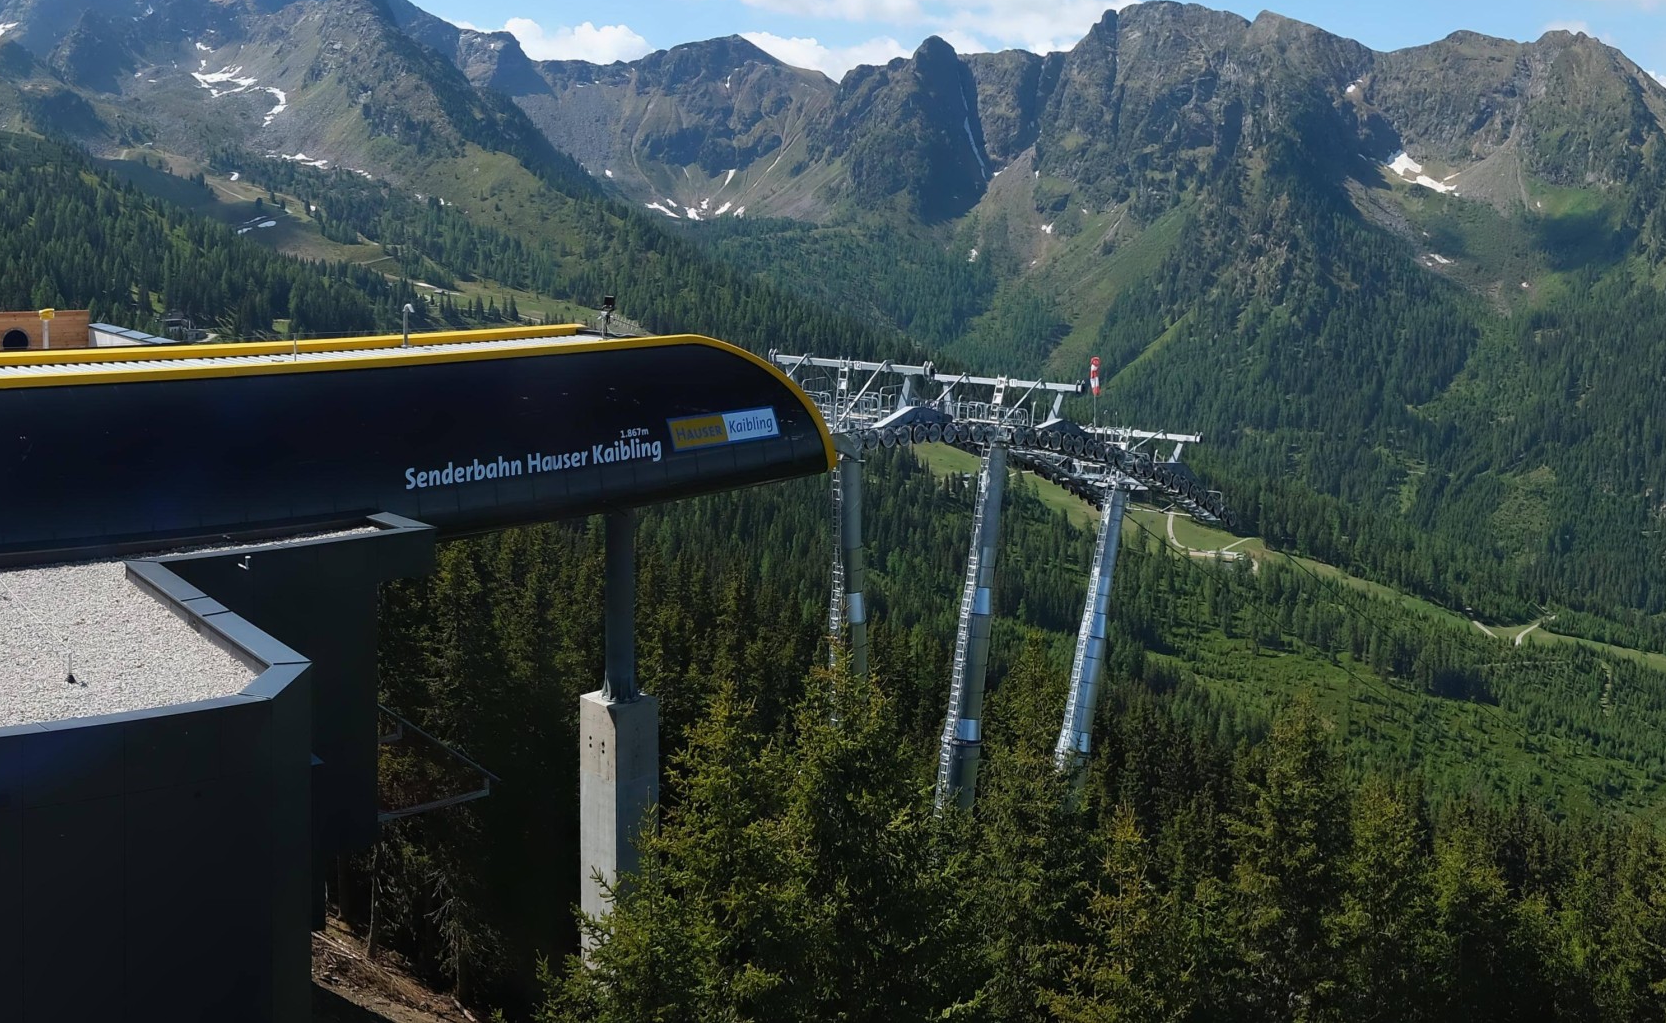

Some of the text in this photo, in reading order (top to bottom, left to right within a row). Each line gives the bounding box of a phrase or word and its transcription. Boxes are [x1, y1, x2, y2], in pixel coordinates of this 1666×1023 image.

[620, 427, 649, 439] 1.867m
[676, 415, 773, 442] HAUSER Kaibling
[404, 438, 662, 490] Senderbahn Hauser Kaibling
